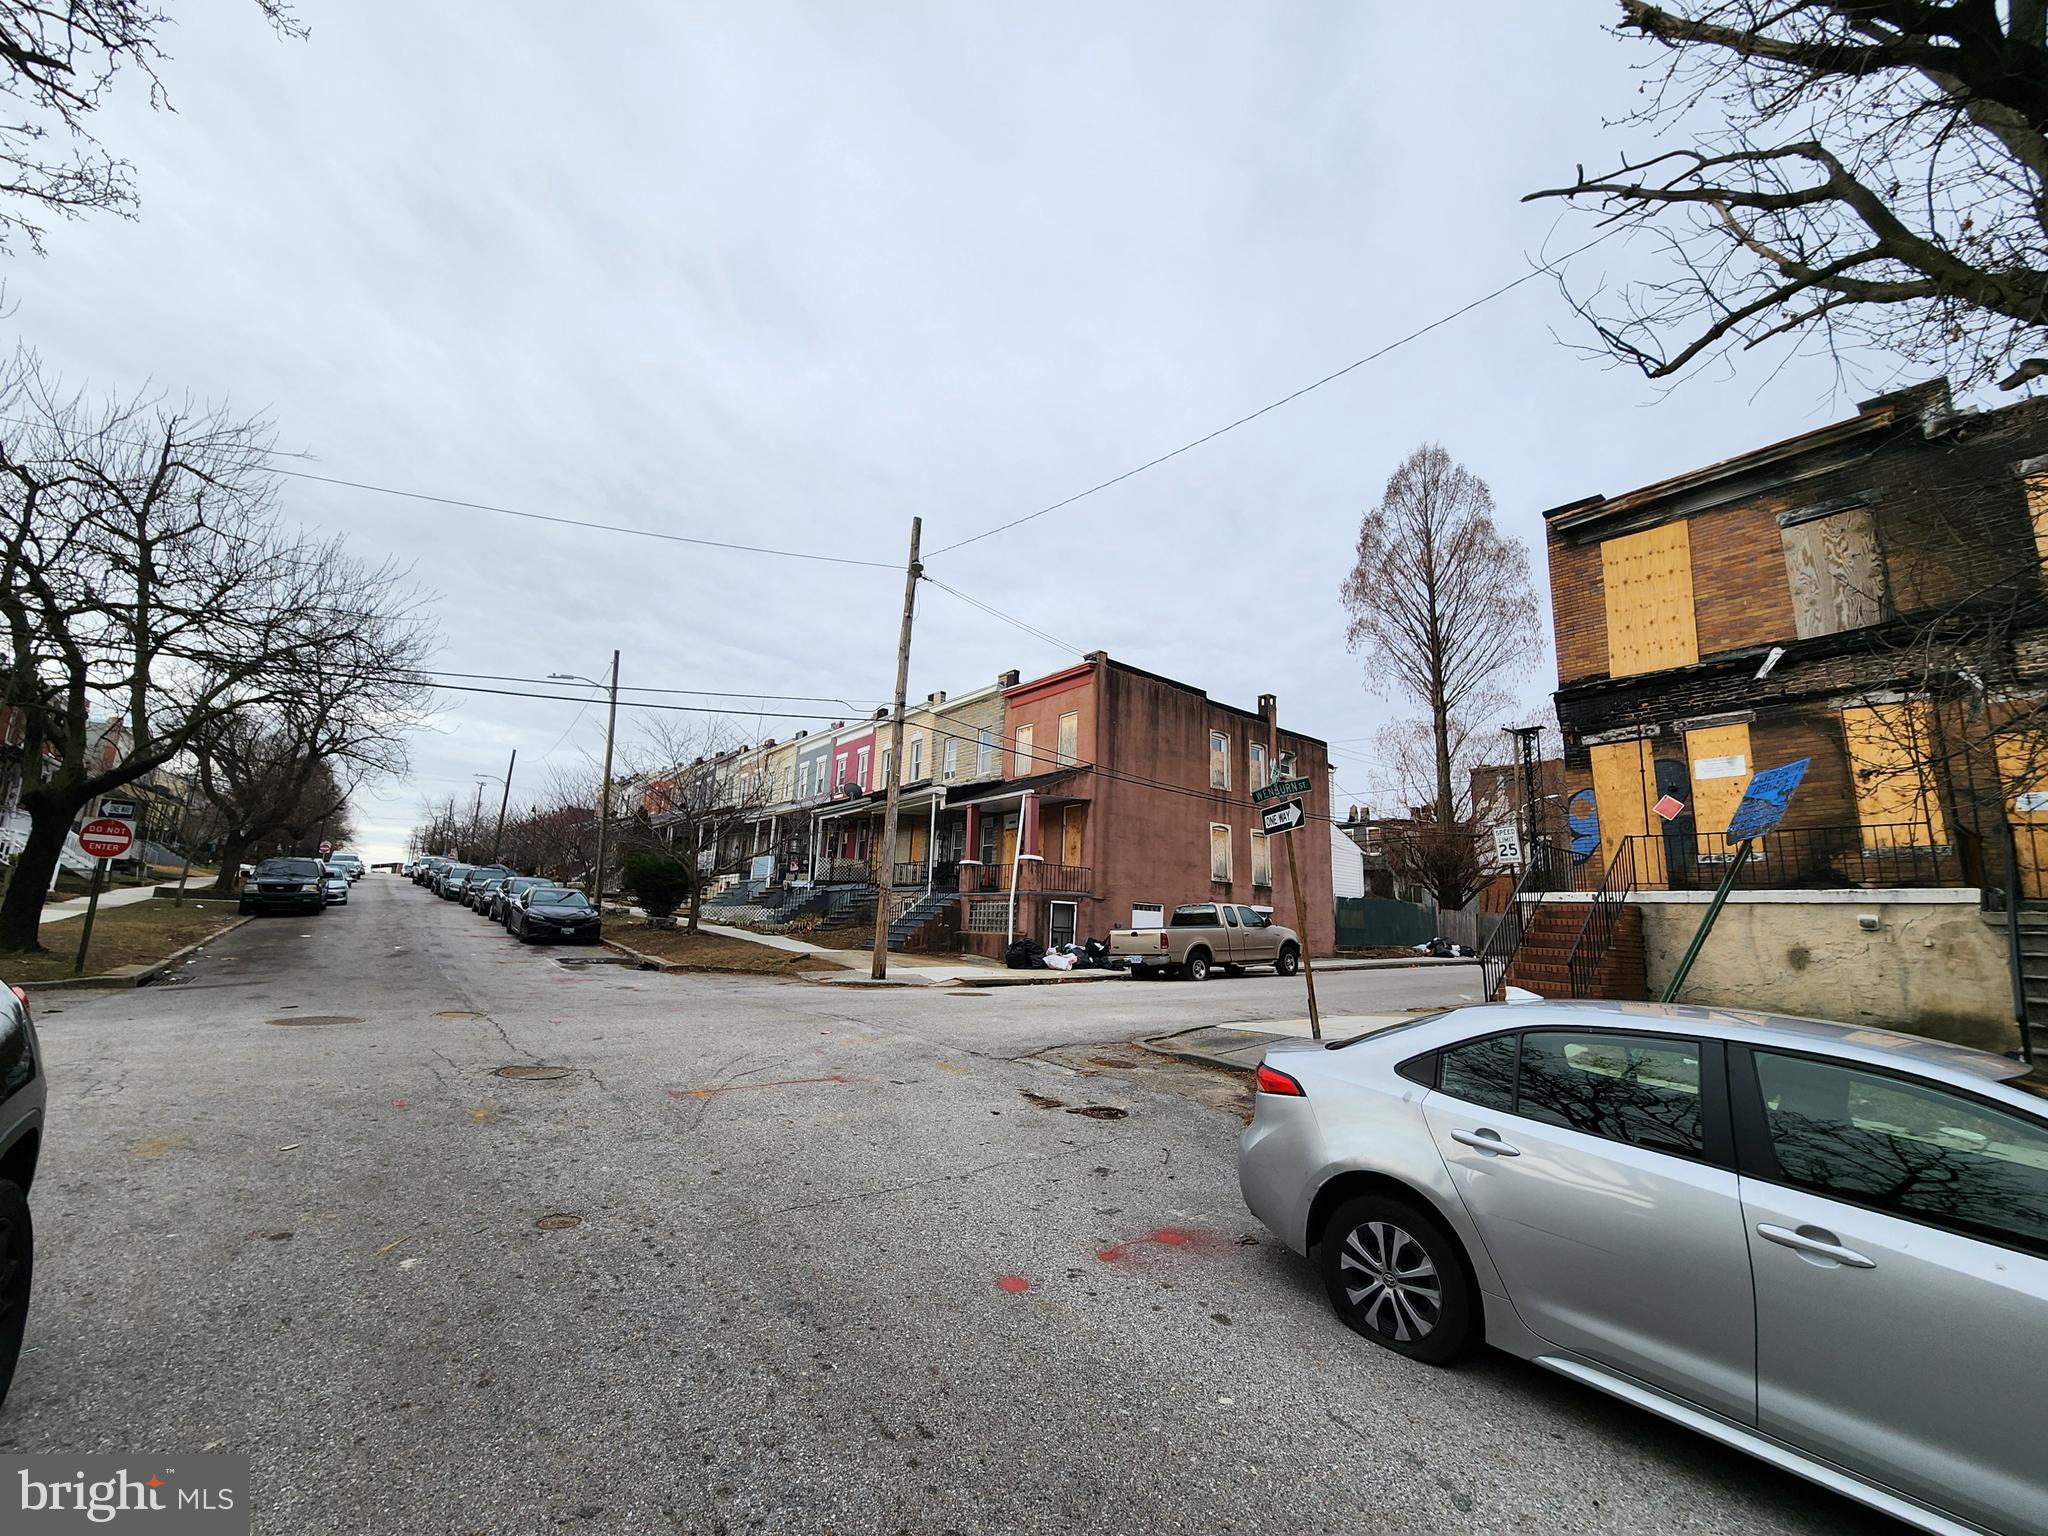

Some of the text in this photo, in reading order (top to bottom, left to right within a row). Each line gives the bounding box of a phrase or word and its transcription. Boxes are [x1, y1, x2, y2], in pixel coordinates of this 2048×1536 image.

[1255, 782, 1298, 801] WENBURN
[1266, 810, 1290, 827] ONE WAY
[106, 827, 126, 835] NOT
[1495, 828, 1515, 836] SPEED
[89, 843, 119, 852] ENTER
[1499, 843, 1518, 857] 25
